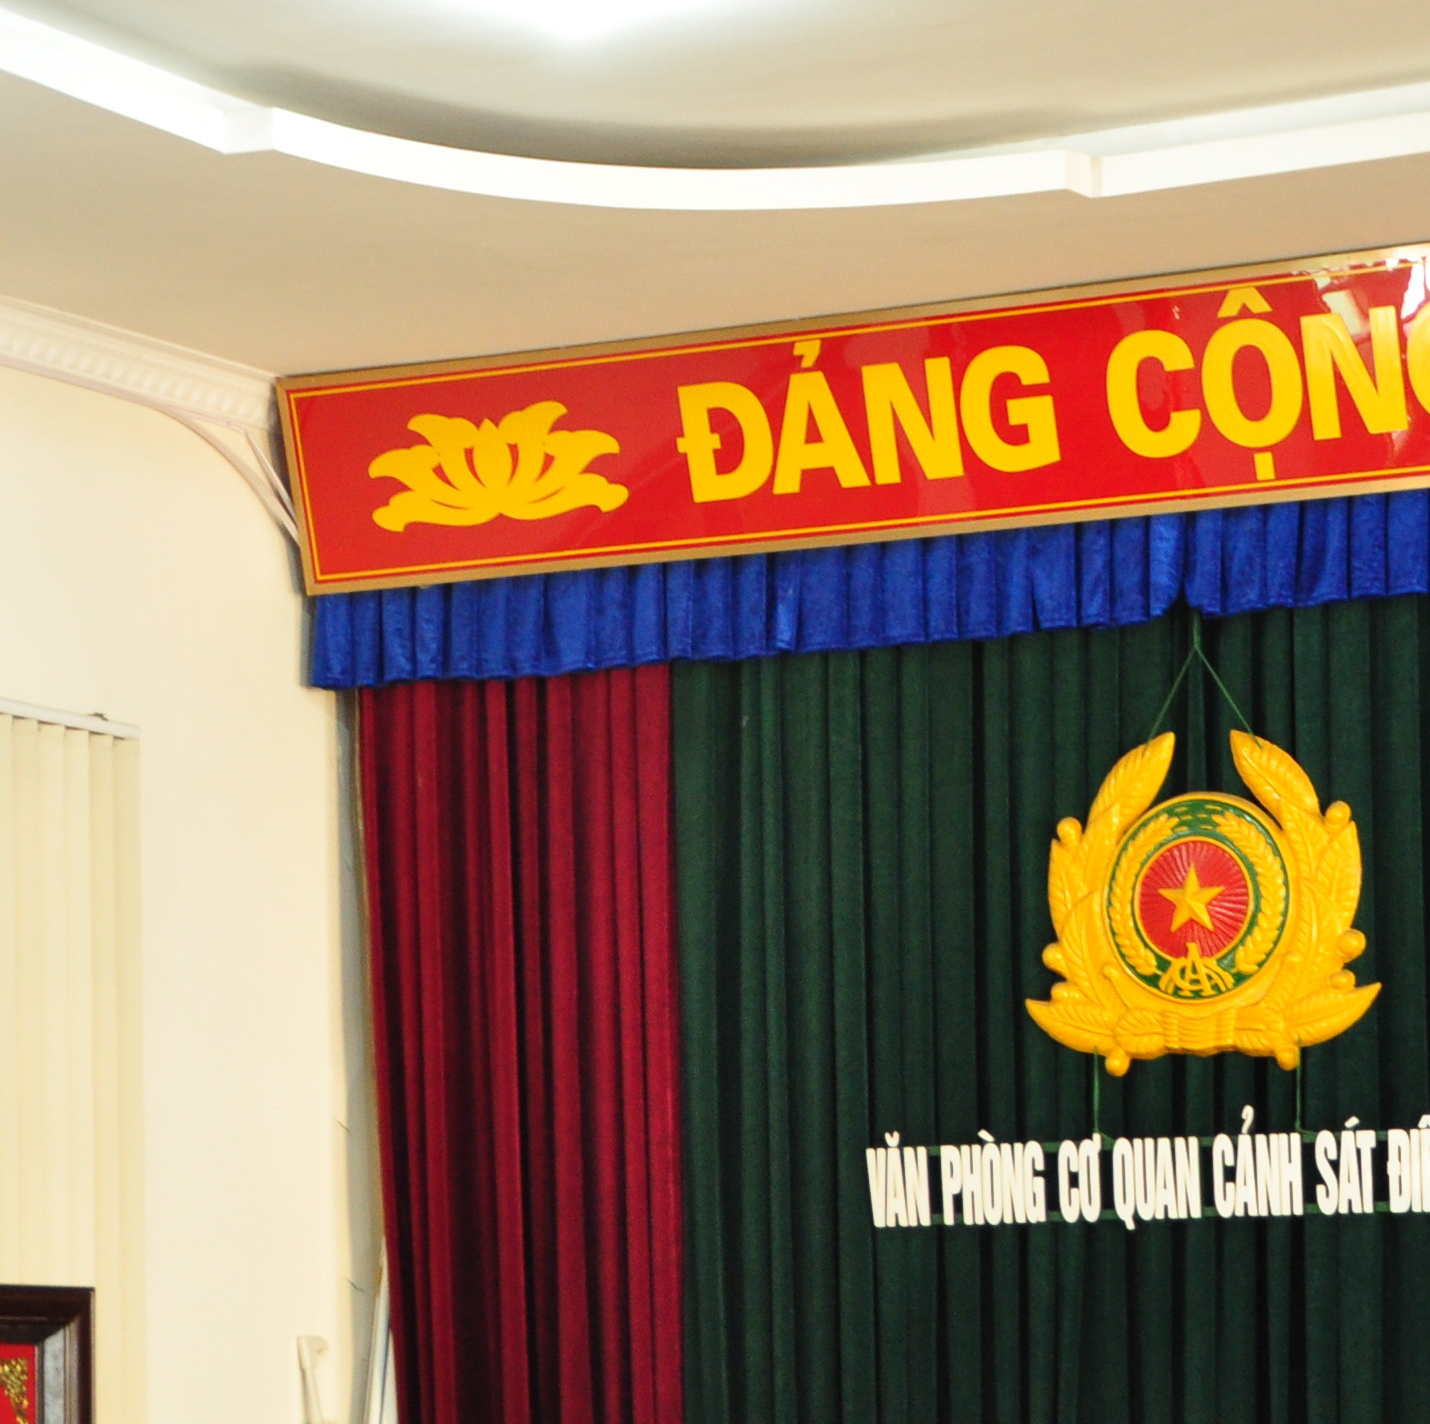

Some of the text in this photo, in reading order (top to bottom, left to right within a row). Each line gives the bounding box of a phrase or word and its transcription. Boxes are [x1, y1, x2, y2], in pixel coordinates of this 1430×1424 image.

[676, 339, 1061, 503] ĐẢNG
[866, 1132, 930, 1227] VĂN
[940, 1130, 1046, 1225] PHÒNG
[1058, 1133, 1101, 1223] CƠ
[1113, 1137, 1201, 1230] QUAN
[1213, 1105, 1303, 1218] CẢNH
[1315, 1117, 1376, 1215] SÁT
